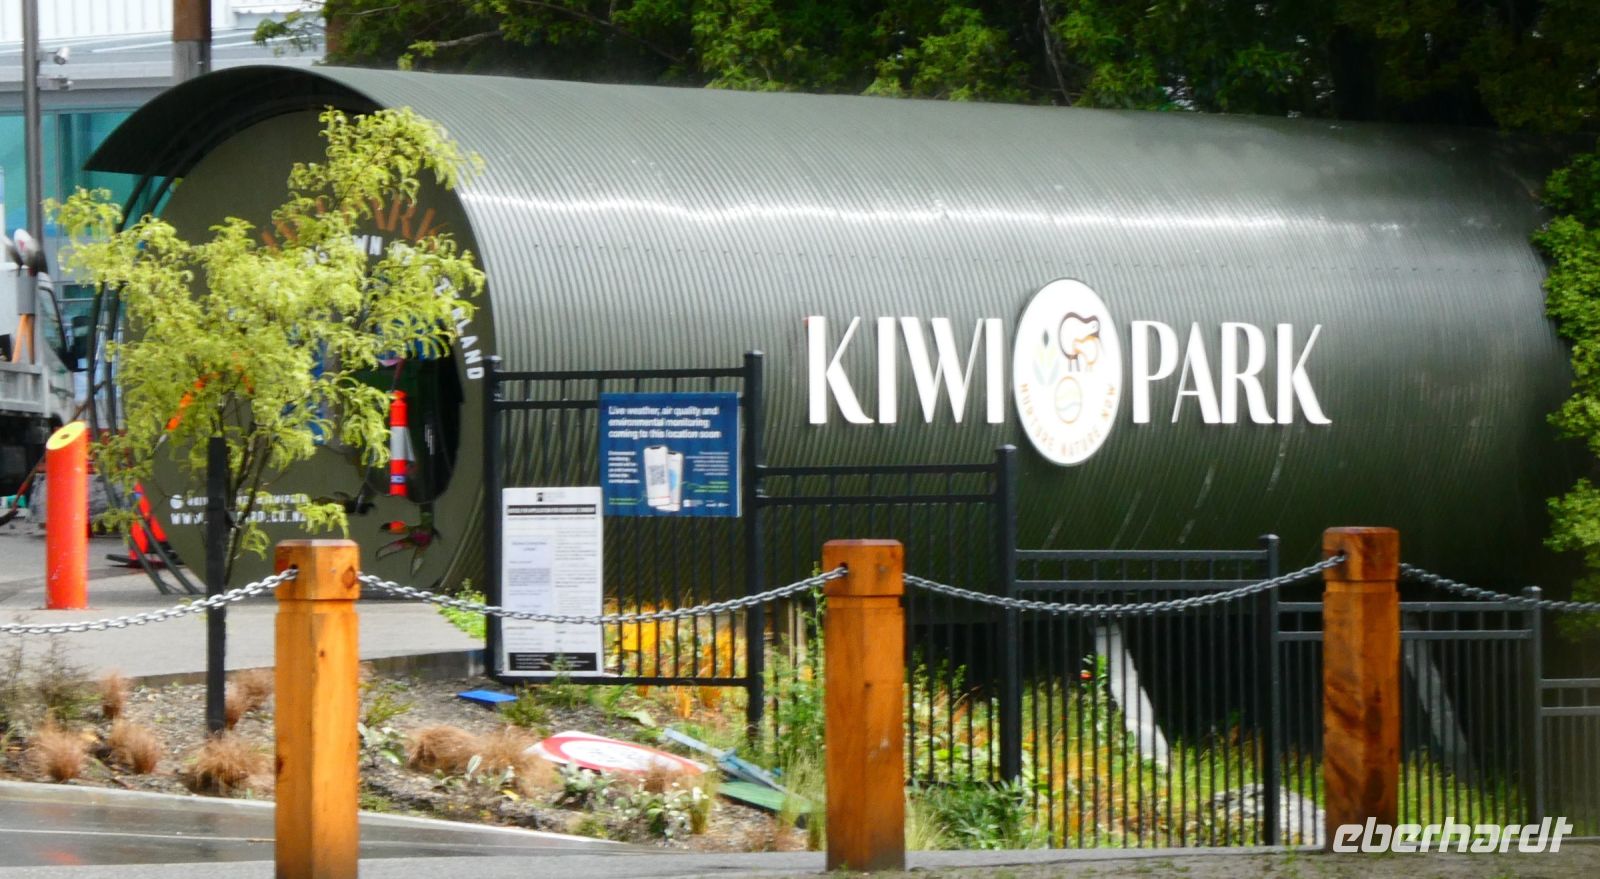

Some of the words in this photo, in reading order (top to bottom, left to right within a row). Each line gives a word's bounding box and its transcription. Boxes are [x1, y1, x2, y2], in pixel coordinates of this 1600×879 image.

[807, 315, 1004, 425] KIWI
[1131, 319, 1332, 425] PARK
[608, 406, 625, 415] Live
[627, 406, 660, 416] weather,
[662, 406, 673, 415] air
[674, 406, 700, 417] quality
[702, 406, 720, 415] and
[608, 418, 665, 427] environmental
[666, 418, 711, 429] monitoring
[608, 430, 638, 440] coming
[639, 430, 648, 438] to
[649, 430, 665, 438] this
[666, 430, 698, 438] location
